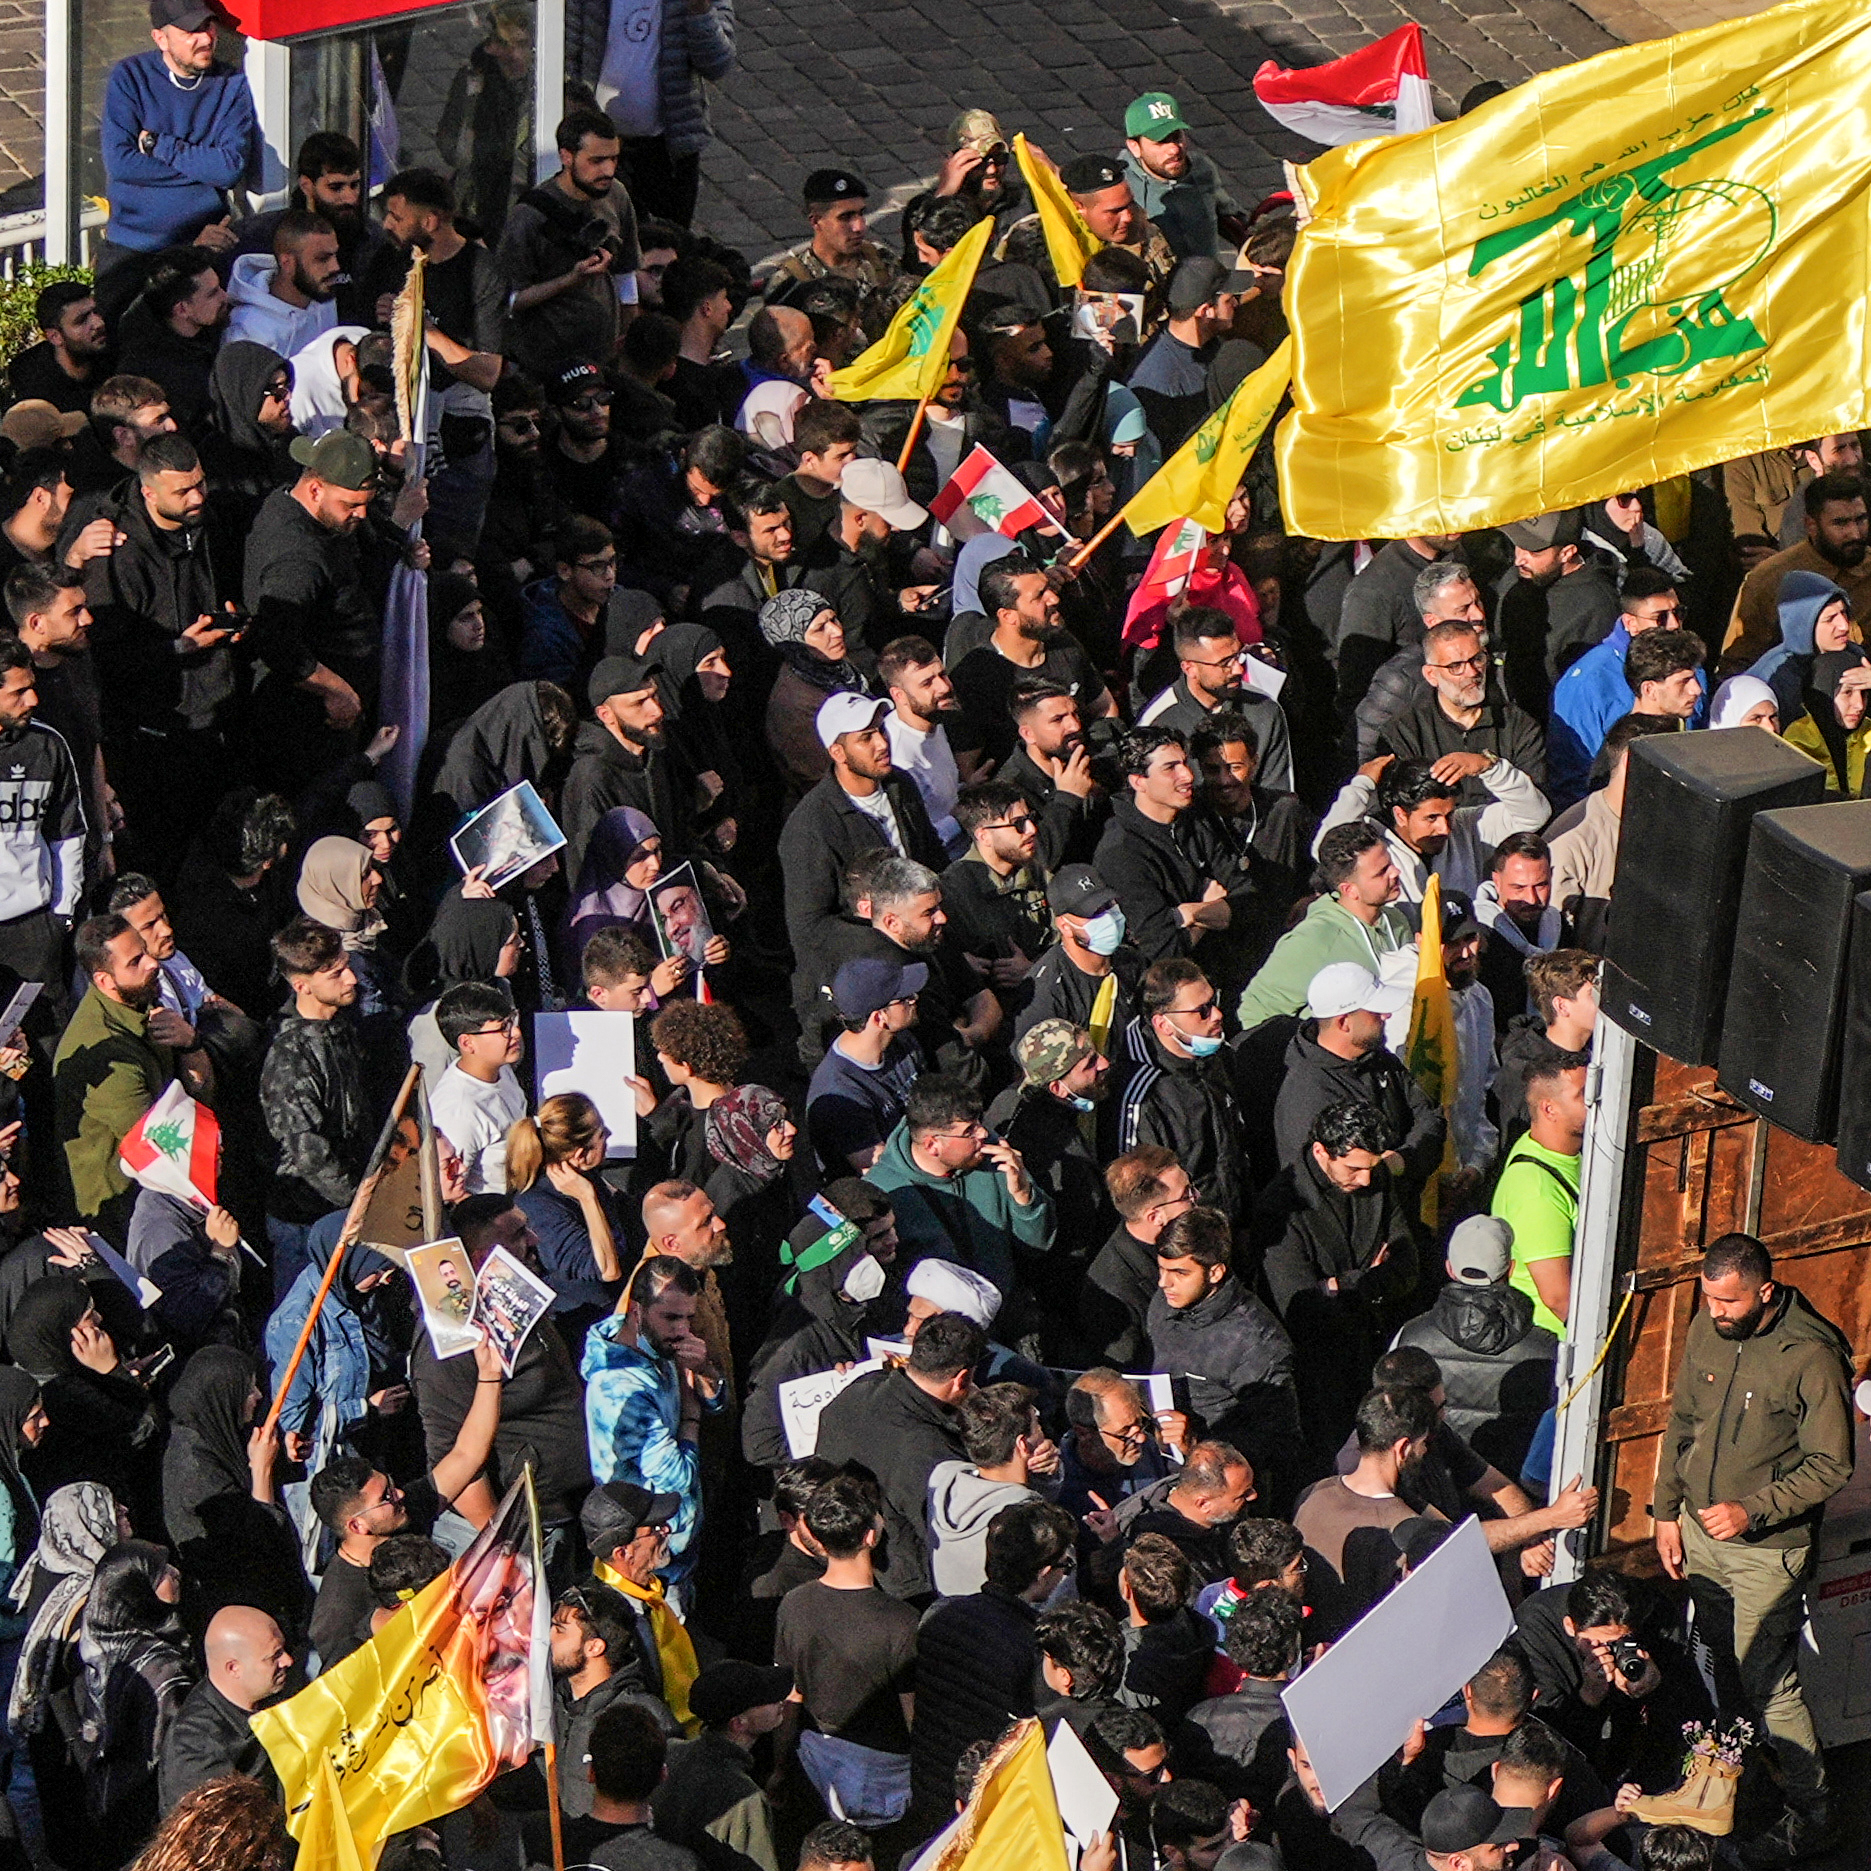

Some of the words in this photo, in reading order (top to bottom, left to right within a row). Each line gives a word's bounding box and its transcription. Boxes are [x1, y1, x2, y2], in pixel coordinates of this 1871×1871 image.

[1148, 101, 1175, 120] NY
[562, 364, 598, 383] HUGO
[1445, 423, 1504, 453] لبنان
